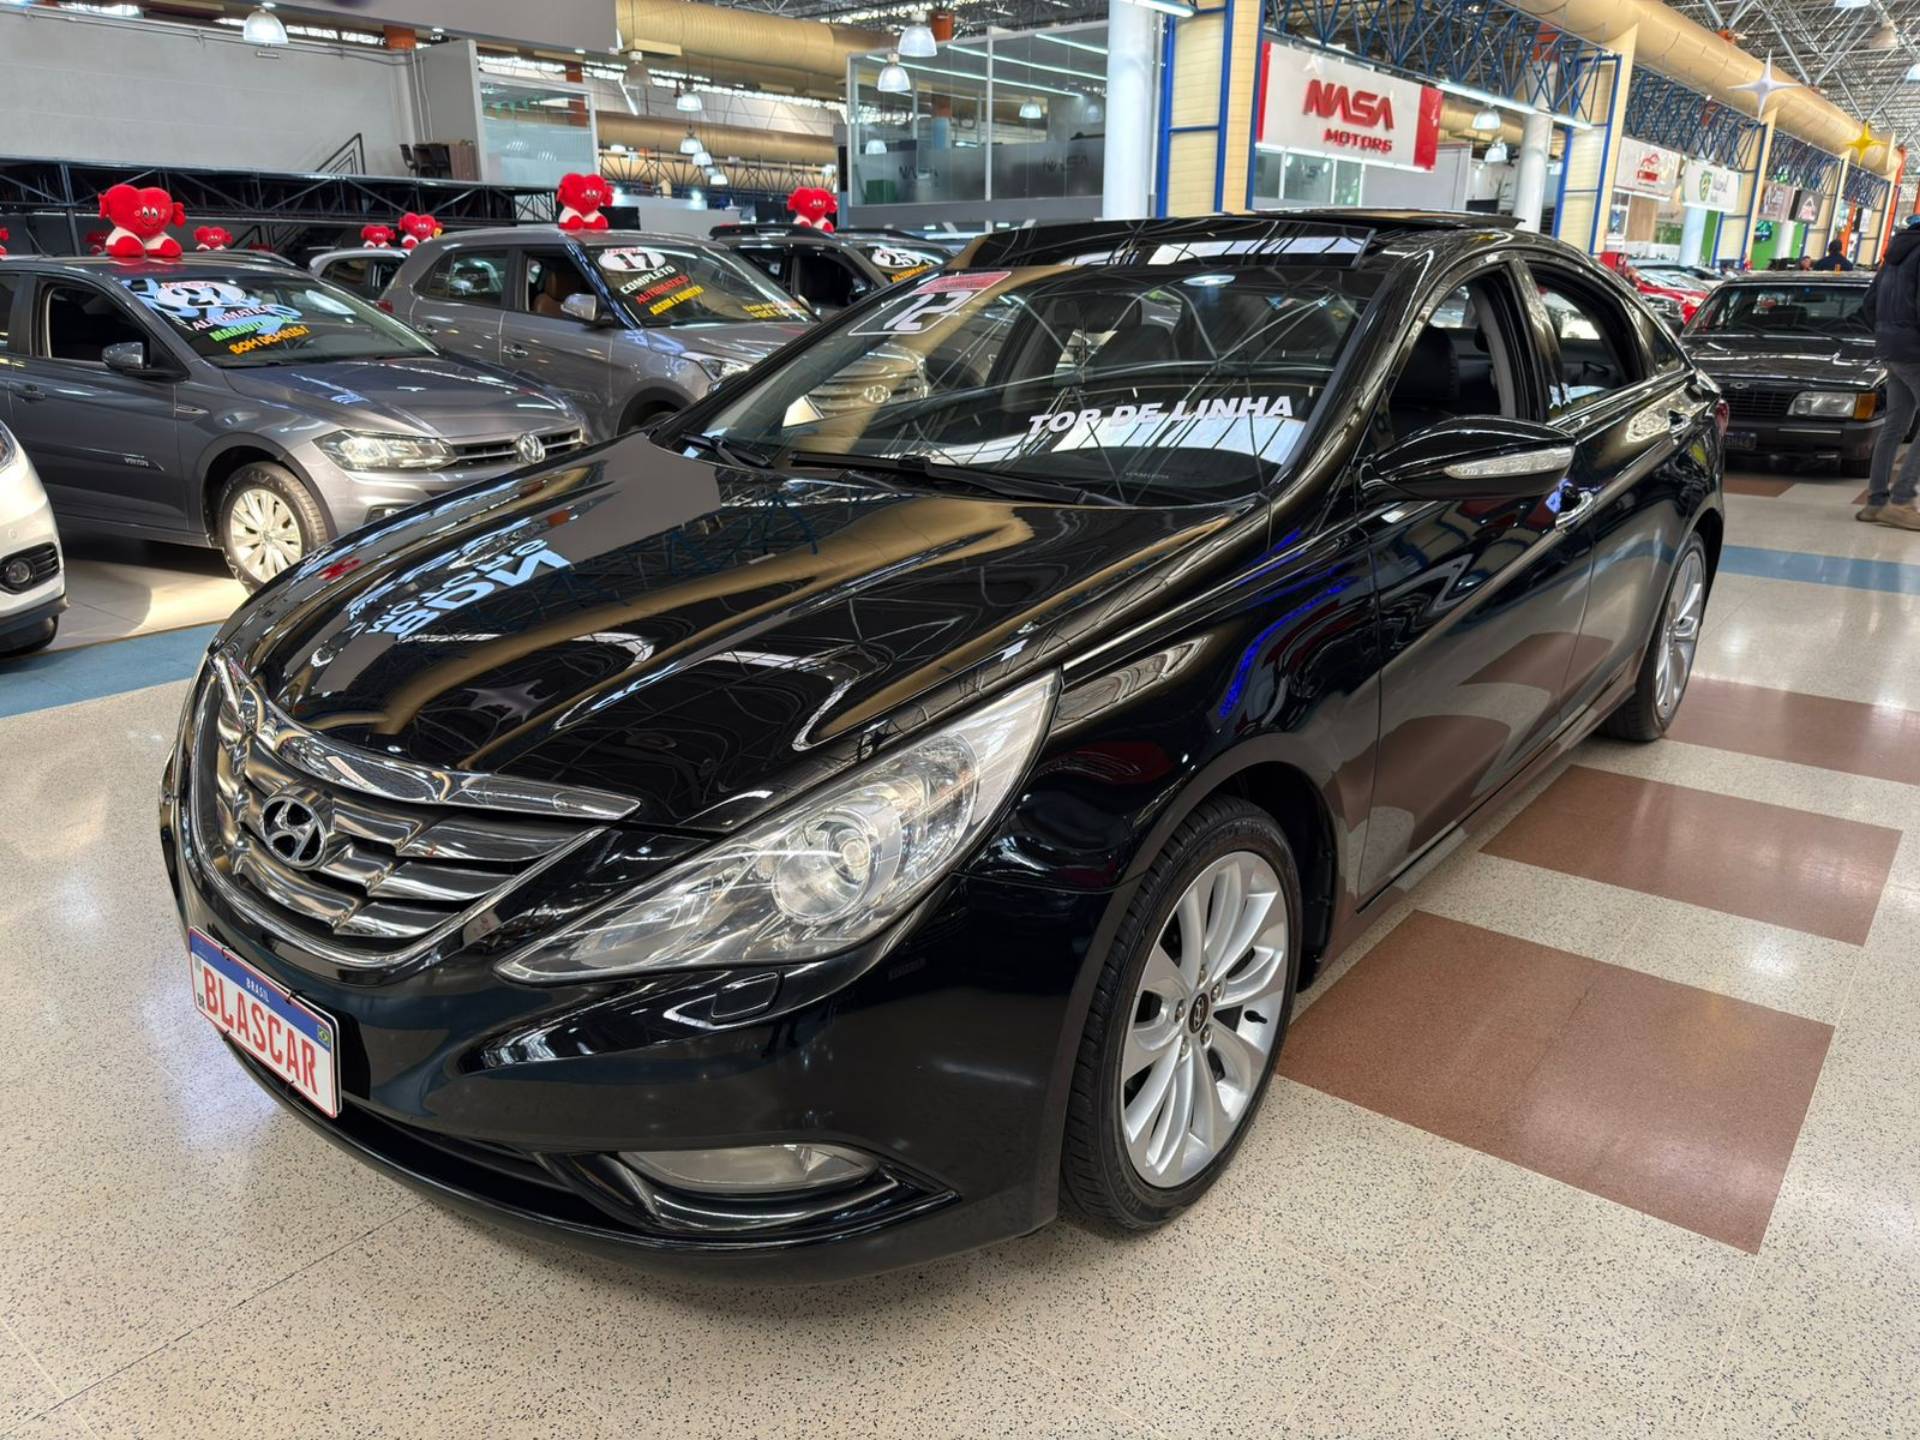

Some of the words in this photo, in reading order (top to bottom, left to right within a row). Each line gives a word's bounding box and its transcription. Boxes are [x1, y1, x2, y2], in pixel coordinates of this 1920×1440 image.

[1303, 79, 1394, 131] NASA
[1323, 128, 1392, 154] MOTORS
[612, 252, 656, 270] 17
[620, 265, 677, 295] COMPLETO
[229, 337, 263, 355] BOM
[1029, 408, 1102, 434] TOP
[1108, 402, 1164, 427] DE
[1170, 395, 1293, 421] LINHA
[246, 976, 270, 1003] BRASIL
[203, 966, 319, 1096] BLASCAR
